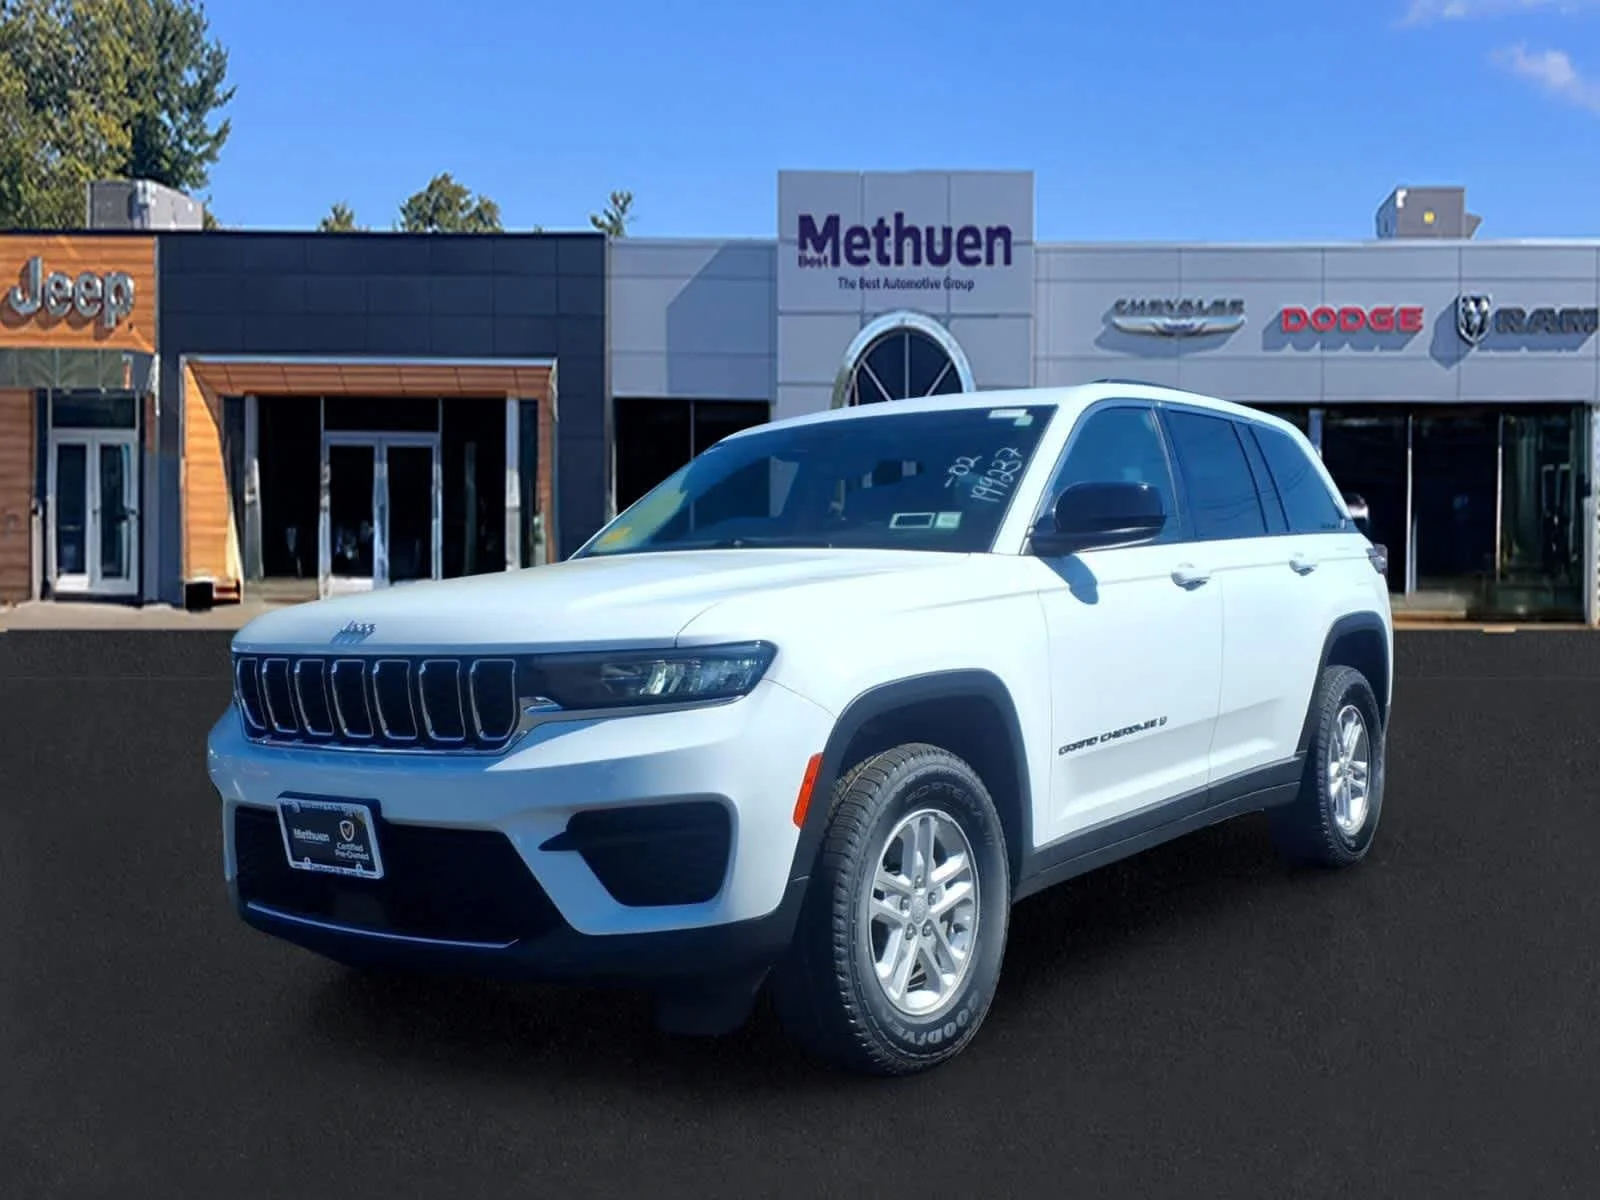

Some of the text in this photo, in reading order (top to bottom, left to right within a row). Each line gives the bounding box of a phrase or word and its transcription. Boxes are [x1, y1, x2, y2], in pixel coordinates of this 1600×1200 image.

[798, 211, 1013, 268] Methuen
[797, 254, 829, 269] Best
[8, 255, 136, 329] Jeep
[838, 276, 975, 292] The Best Automotive Group
[1114, 298, 1245, 316] CHRYSLER
[1281, 305, 1424, 333] DODGE
[1495, 306, 1599, 333] RAM
